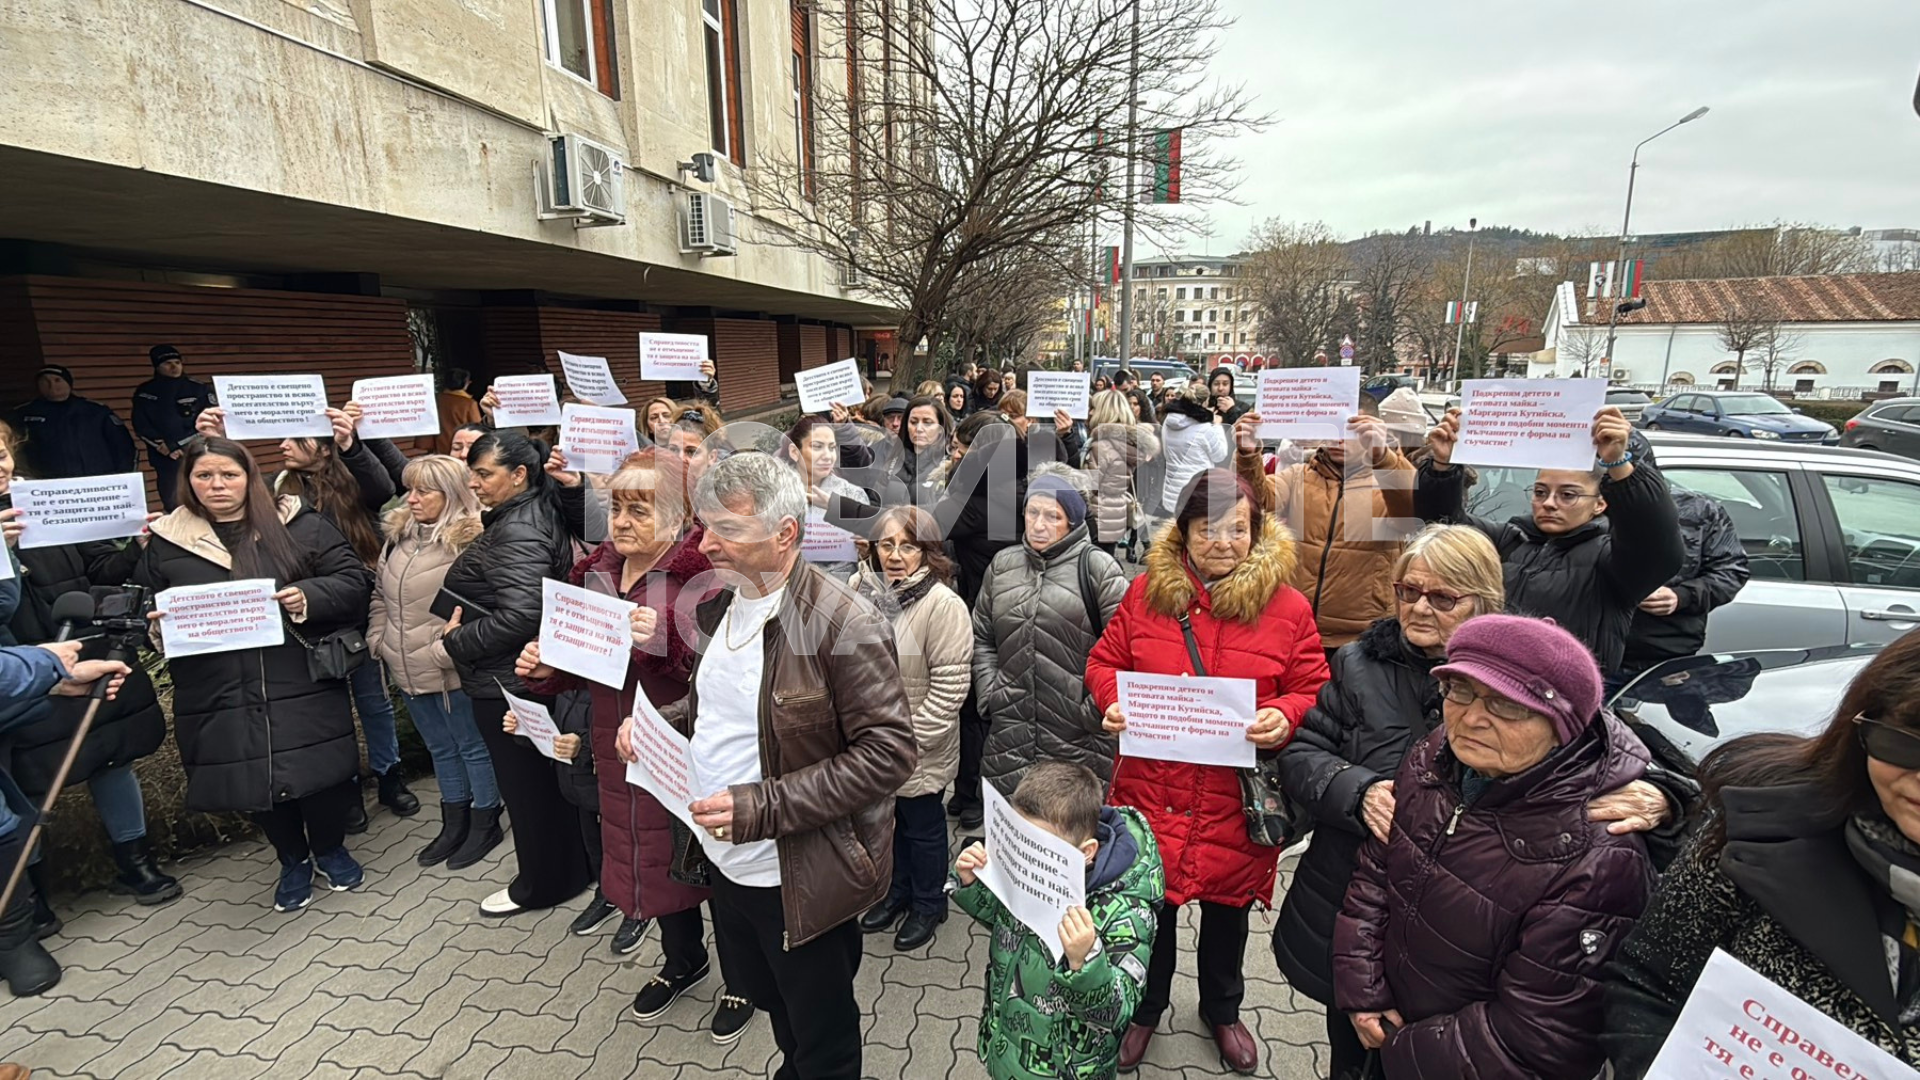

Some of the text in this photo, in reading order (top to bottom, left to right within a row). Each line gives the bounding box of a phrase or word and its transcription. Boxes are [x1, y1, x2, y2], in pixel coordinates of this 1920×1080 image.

[227, 392, 282, 400] пространство
[1472, 390, 1520, 398] Подкрепям
[1468, 409, 1517, 417] Маргарита
[257, 416, 304, 424] обществото
[1508, 420, 1544, 428] подобни
[1527, 430, 1556, 439] форма
[31, 484, 128, 496] Справедливостта
[58, 495, 120, 504] отмъщение
[53, 506, 94, 515] защита
[113, 502, 136, 510] най-
[42, 514, 119, 525] беззащитните
[169, 592, 215, 603] Детството
[224, 588, 261, 598] свещено
[168, 601, 231, 613] пространство
[174, 605, 265, 620] посегателство върху
[555, 592, 621, 620] Справедливостта
[206, 617, 243, 627] морален
[555, 606, 563, 614] не
[571, 610, 613, 630] отмъщение
[202, 625, 253, 636] обществото
[565, 621, 593, 636] защита
[595, 631, 604, 640] на
[606, 635, 623, 646] най-
[554, 630, 607, 654] беззащитните
[1128, 682, 1175, 692] Подкрепям
[1128, 701, 1222, 716] Маргарита Кутийска,
[1168, 714, 1202, 724] подобни
[1205, 719, 1244, 728] моменти
[1129, 721, 1179, 731] мълчанието
[1188, 726, 1216, 736] форма
[1129, 731, 1171, 741] съучастие
[993, 800, 1068, 866] Справедливостта
[993, 817, 1000, 829] не
[1005, 833, 1058, 876] отмъщение
[990, 827, 996, 840] тя
[1002, 844, 1027, 876] защита
[1031, 872, 1044, 885] на
[1048, 881, 1073, 899] най-
[996, 848, 1053, 905] беззащитните
[1729, 1024, 1784, 1067] не е
[1703, 1036, 1754, 1080] тя е
